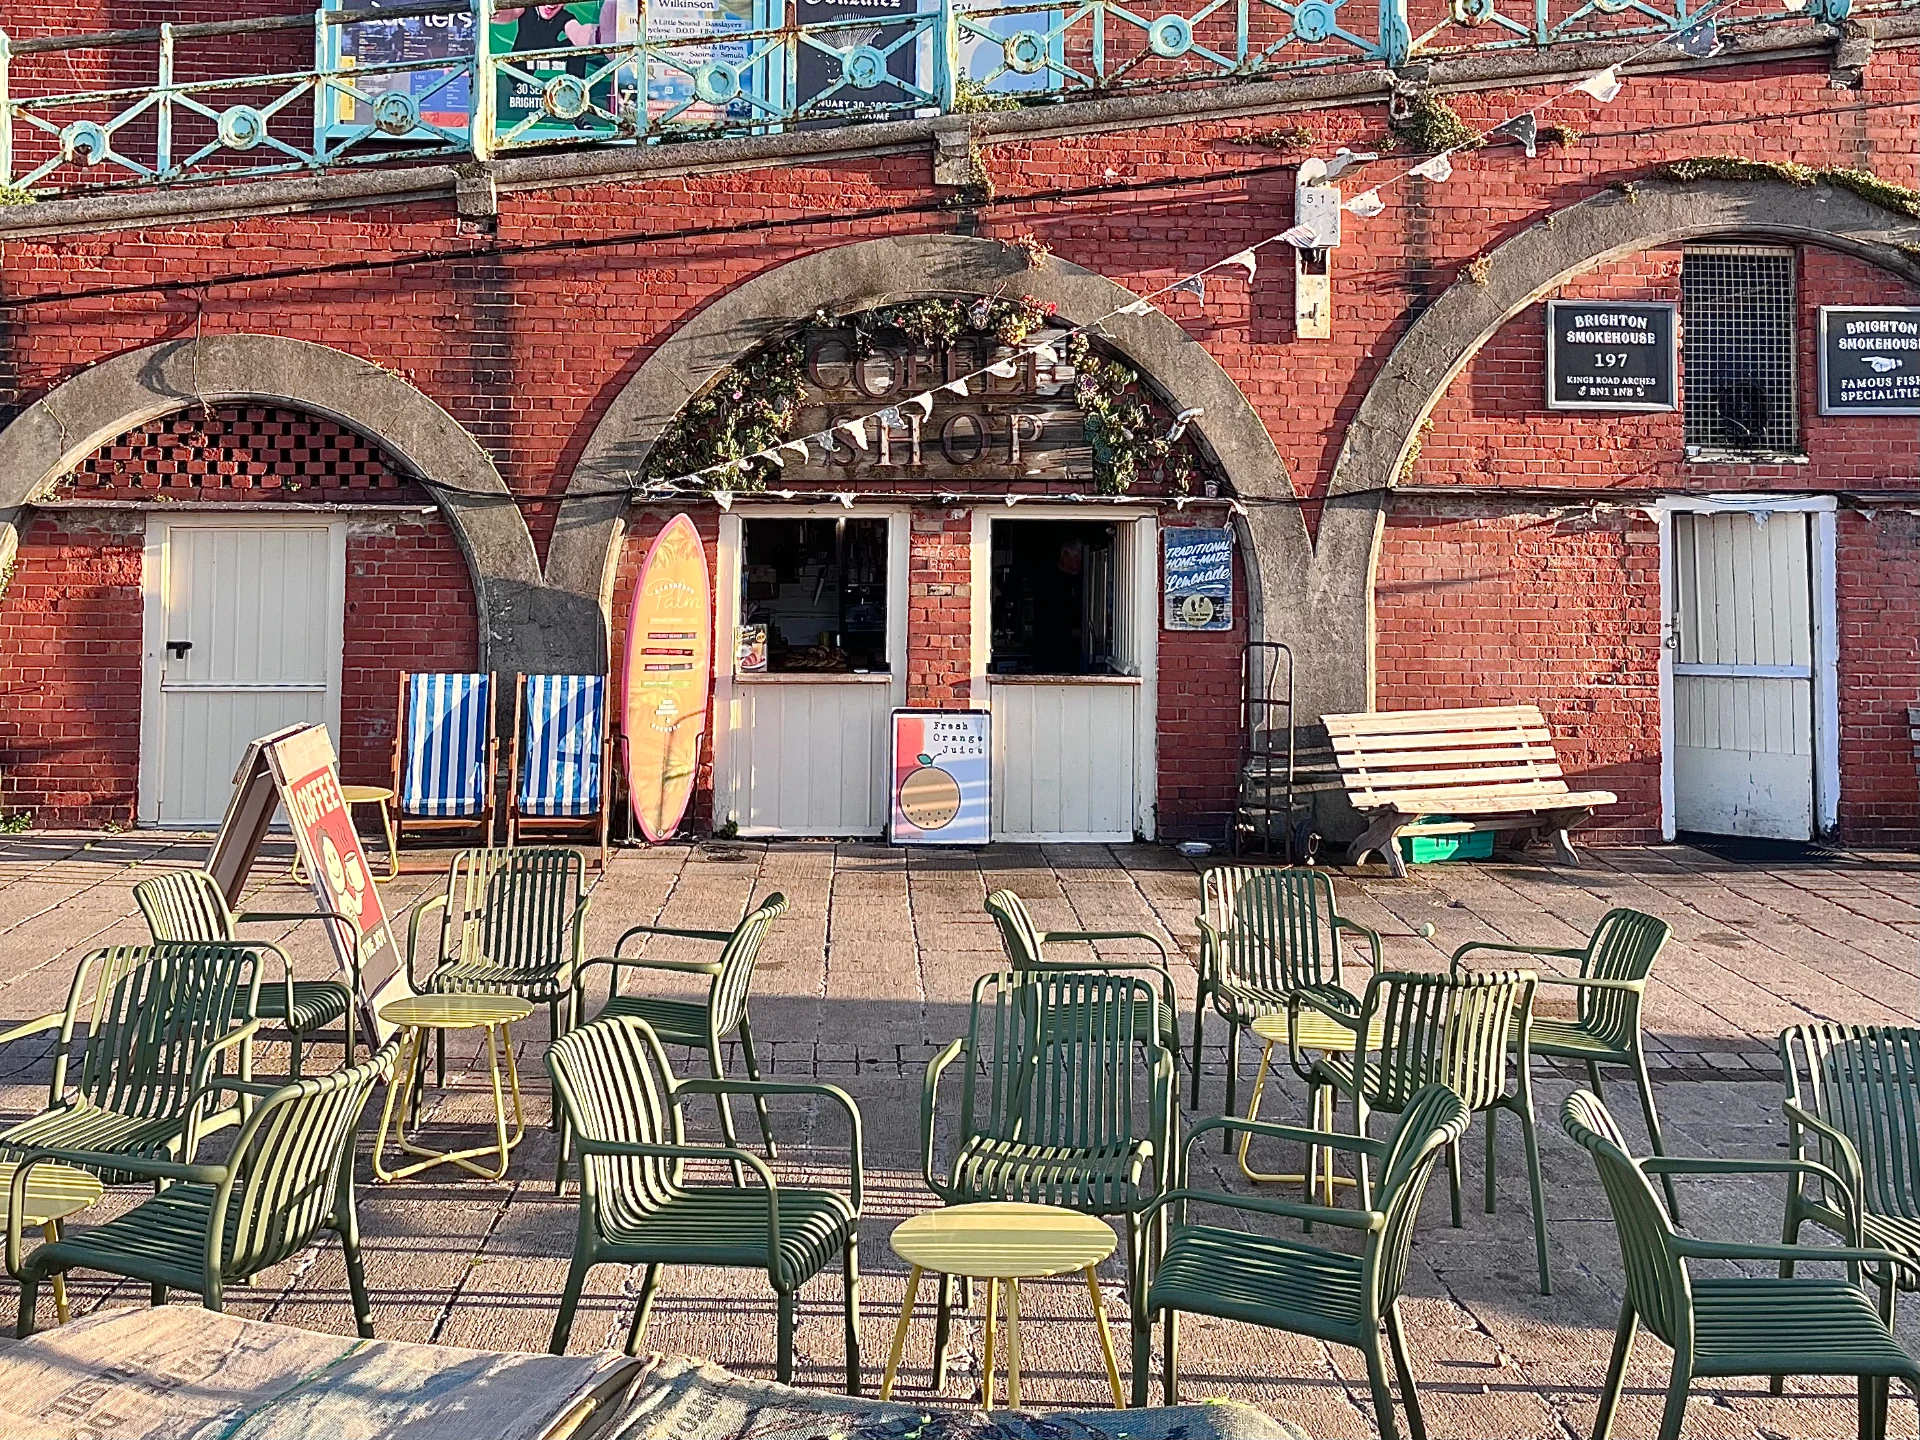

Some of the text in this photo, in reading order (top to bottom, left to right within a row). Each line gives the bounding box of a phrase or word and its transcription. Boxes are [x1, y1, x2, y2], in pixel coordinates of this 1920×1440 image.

[659, 0, 714, 9] Wilkinson
[516, 83, 544, 95] 30 SE
[509, 96, 545, 108] BRIGHTO
[815, 99, 850, 108] NUARY
[1574, 313, 1648, 329] BRIGHTON
[1846, 321, 1918, 335] BRIGHTON
[1566, 330, 1656, 344] SMOKEHOUSE
[1594, 353, 1628, 368] 197
[1566, 375, 1656, 385] KINGS ROAD ARCHES
[1841, 377, 1892, 389] FAMOUS
[1590, 387, 1633, 396] BN1 1NB
[824, 411, 1045, 468] SHOP
[1166, 540, 1230, 559] TRADITIONAL
[1166, 550, 1231, 569] HOME-MADE
[1165, 564, 1231, 594] Lemonade
[645, 578, 702, 612] Palm
[933, 721, 968, 730] Fresh
[933, 733, 983, 743] Orange
[942, 745, 983, 754] Juice
[295, 771, 341, 828] COFFEE
